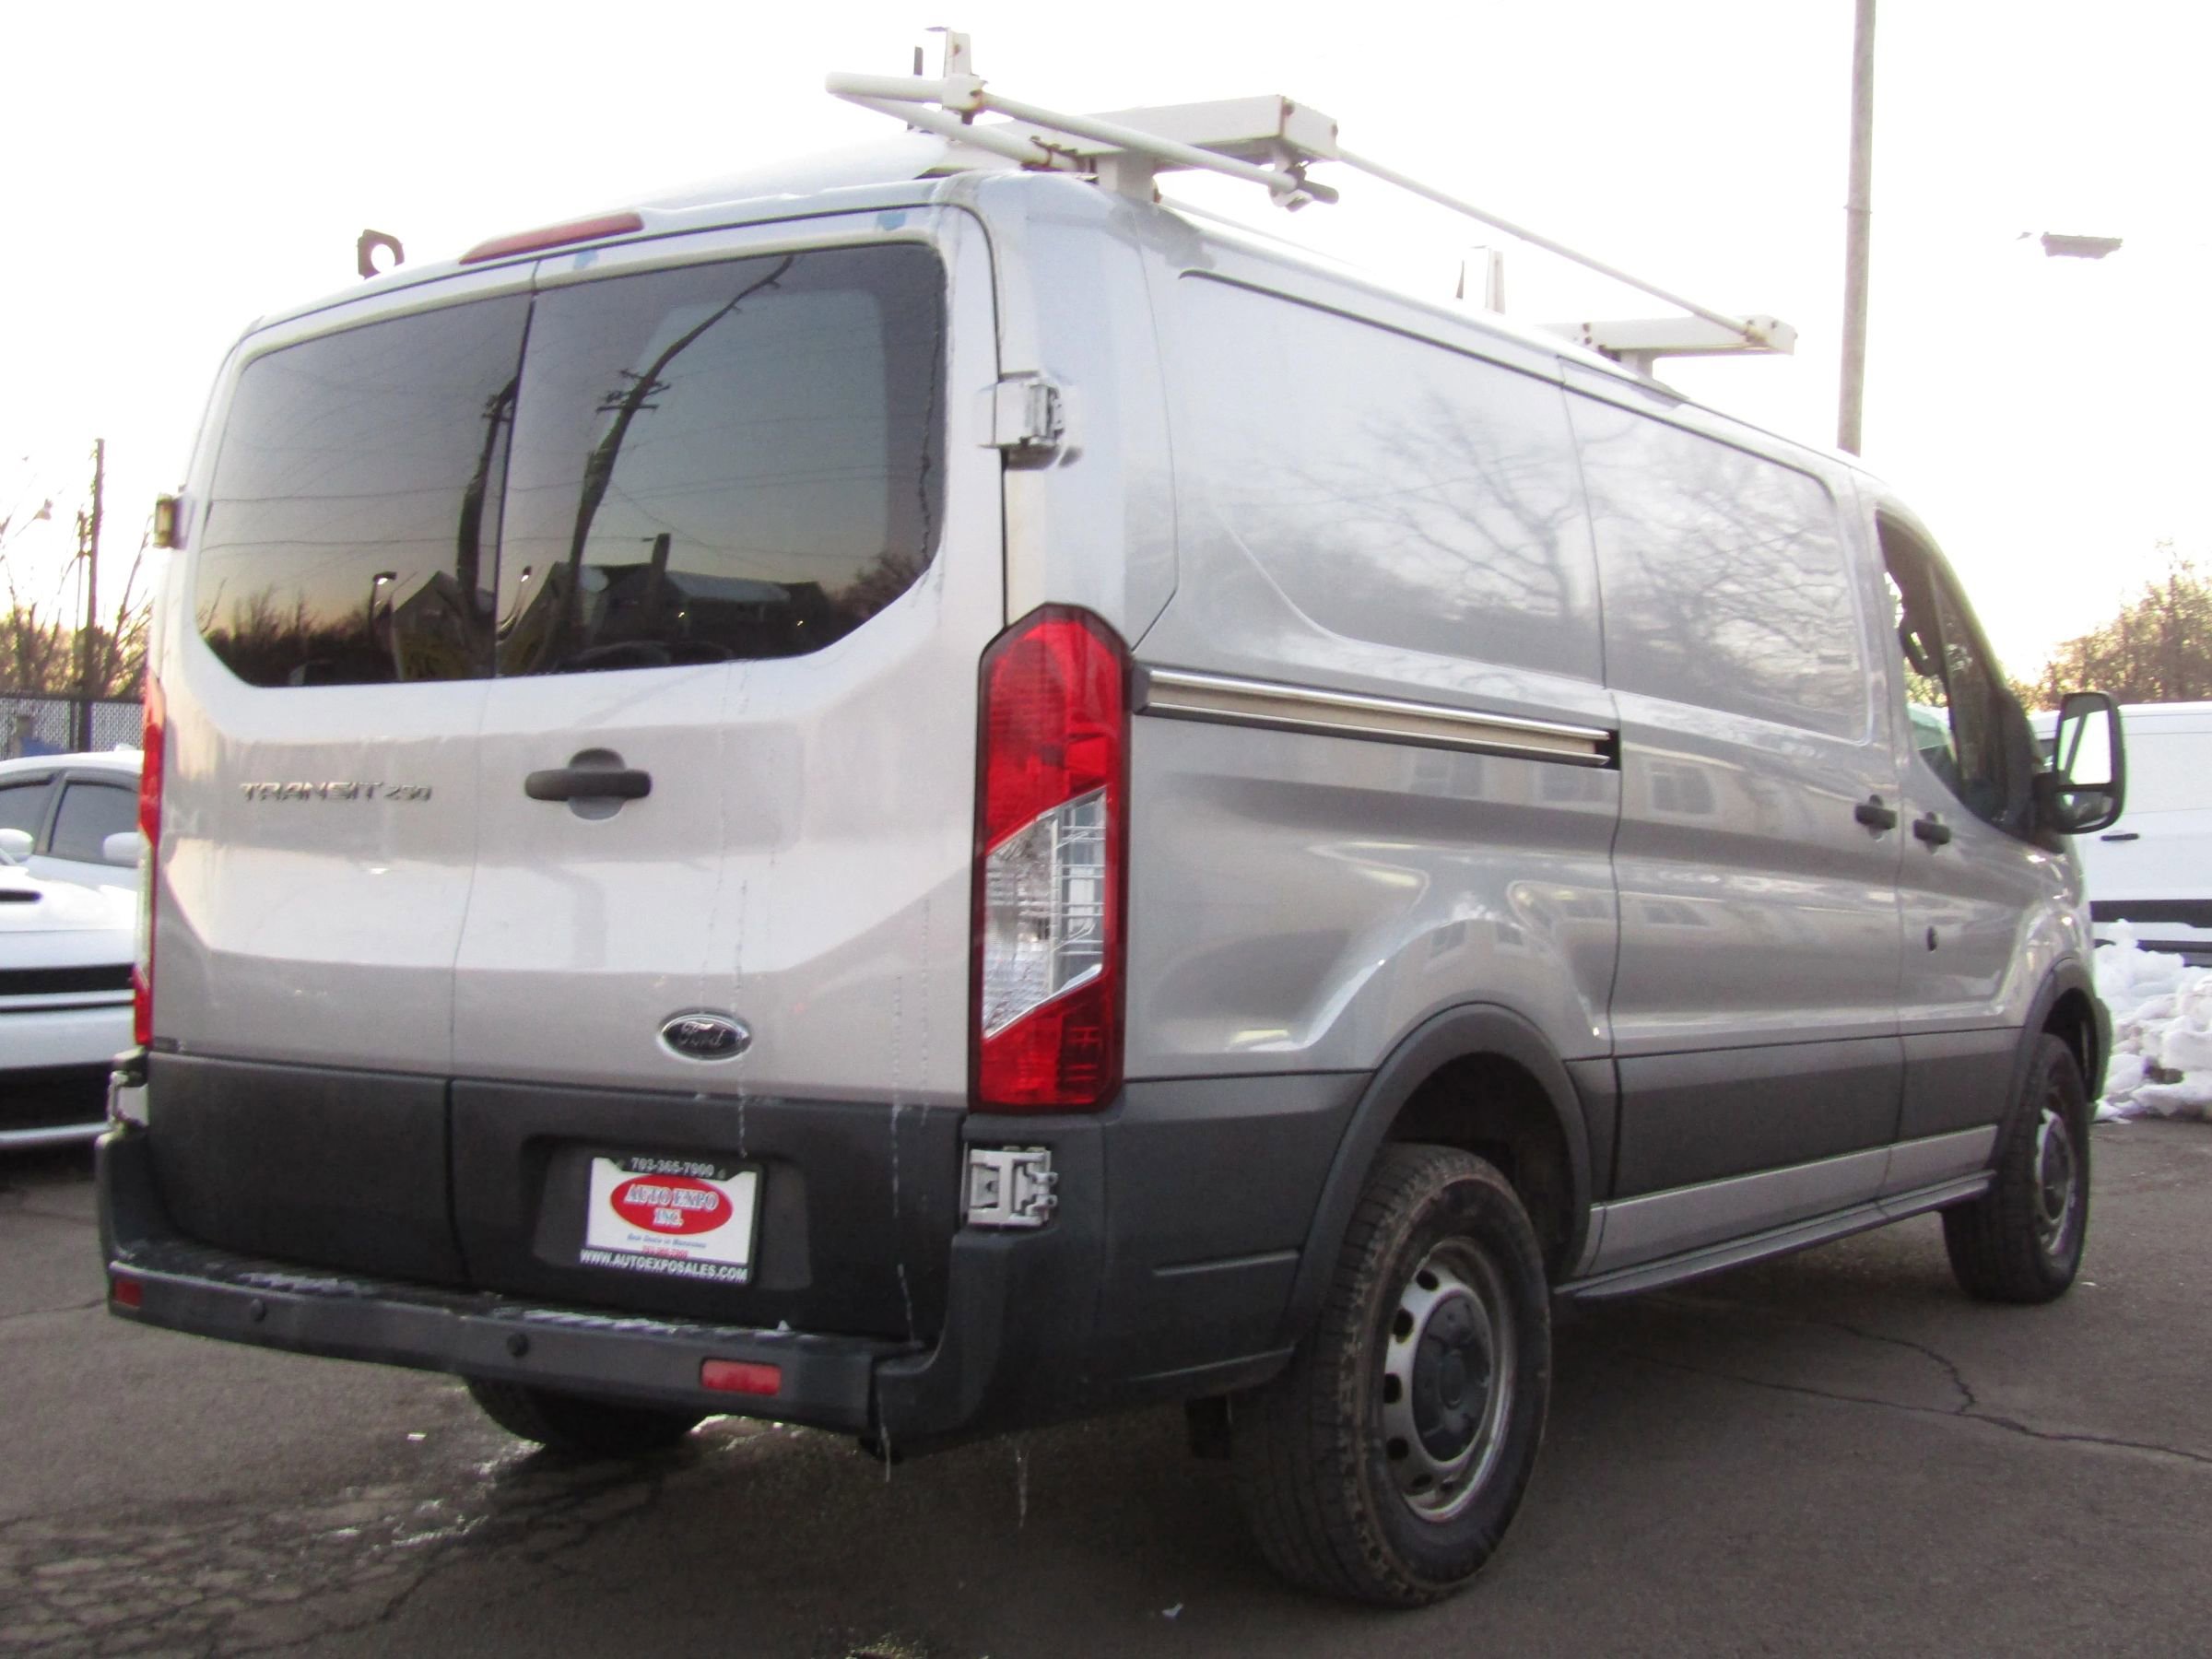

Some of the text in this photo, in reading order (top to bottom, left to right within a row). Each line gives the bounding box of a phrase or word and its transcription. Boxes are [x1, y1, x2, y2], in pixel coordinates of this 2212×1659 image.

[240, 782, 383, 801] TRANSIT
[624, 1183, 719, 1211] AUTO EXPO
[580, 1249, 748, 1282] WWW.AUTOEXPOSALES.COM
